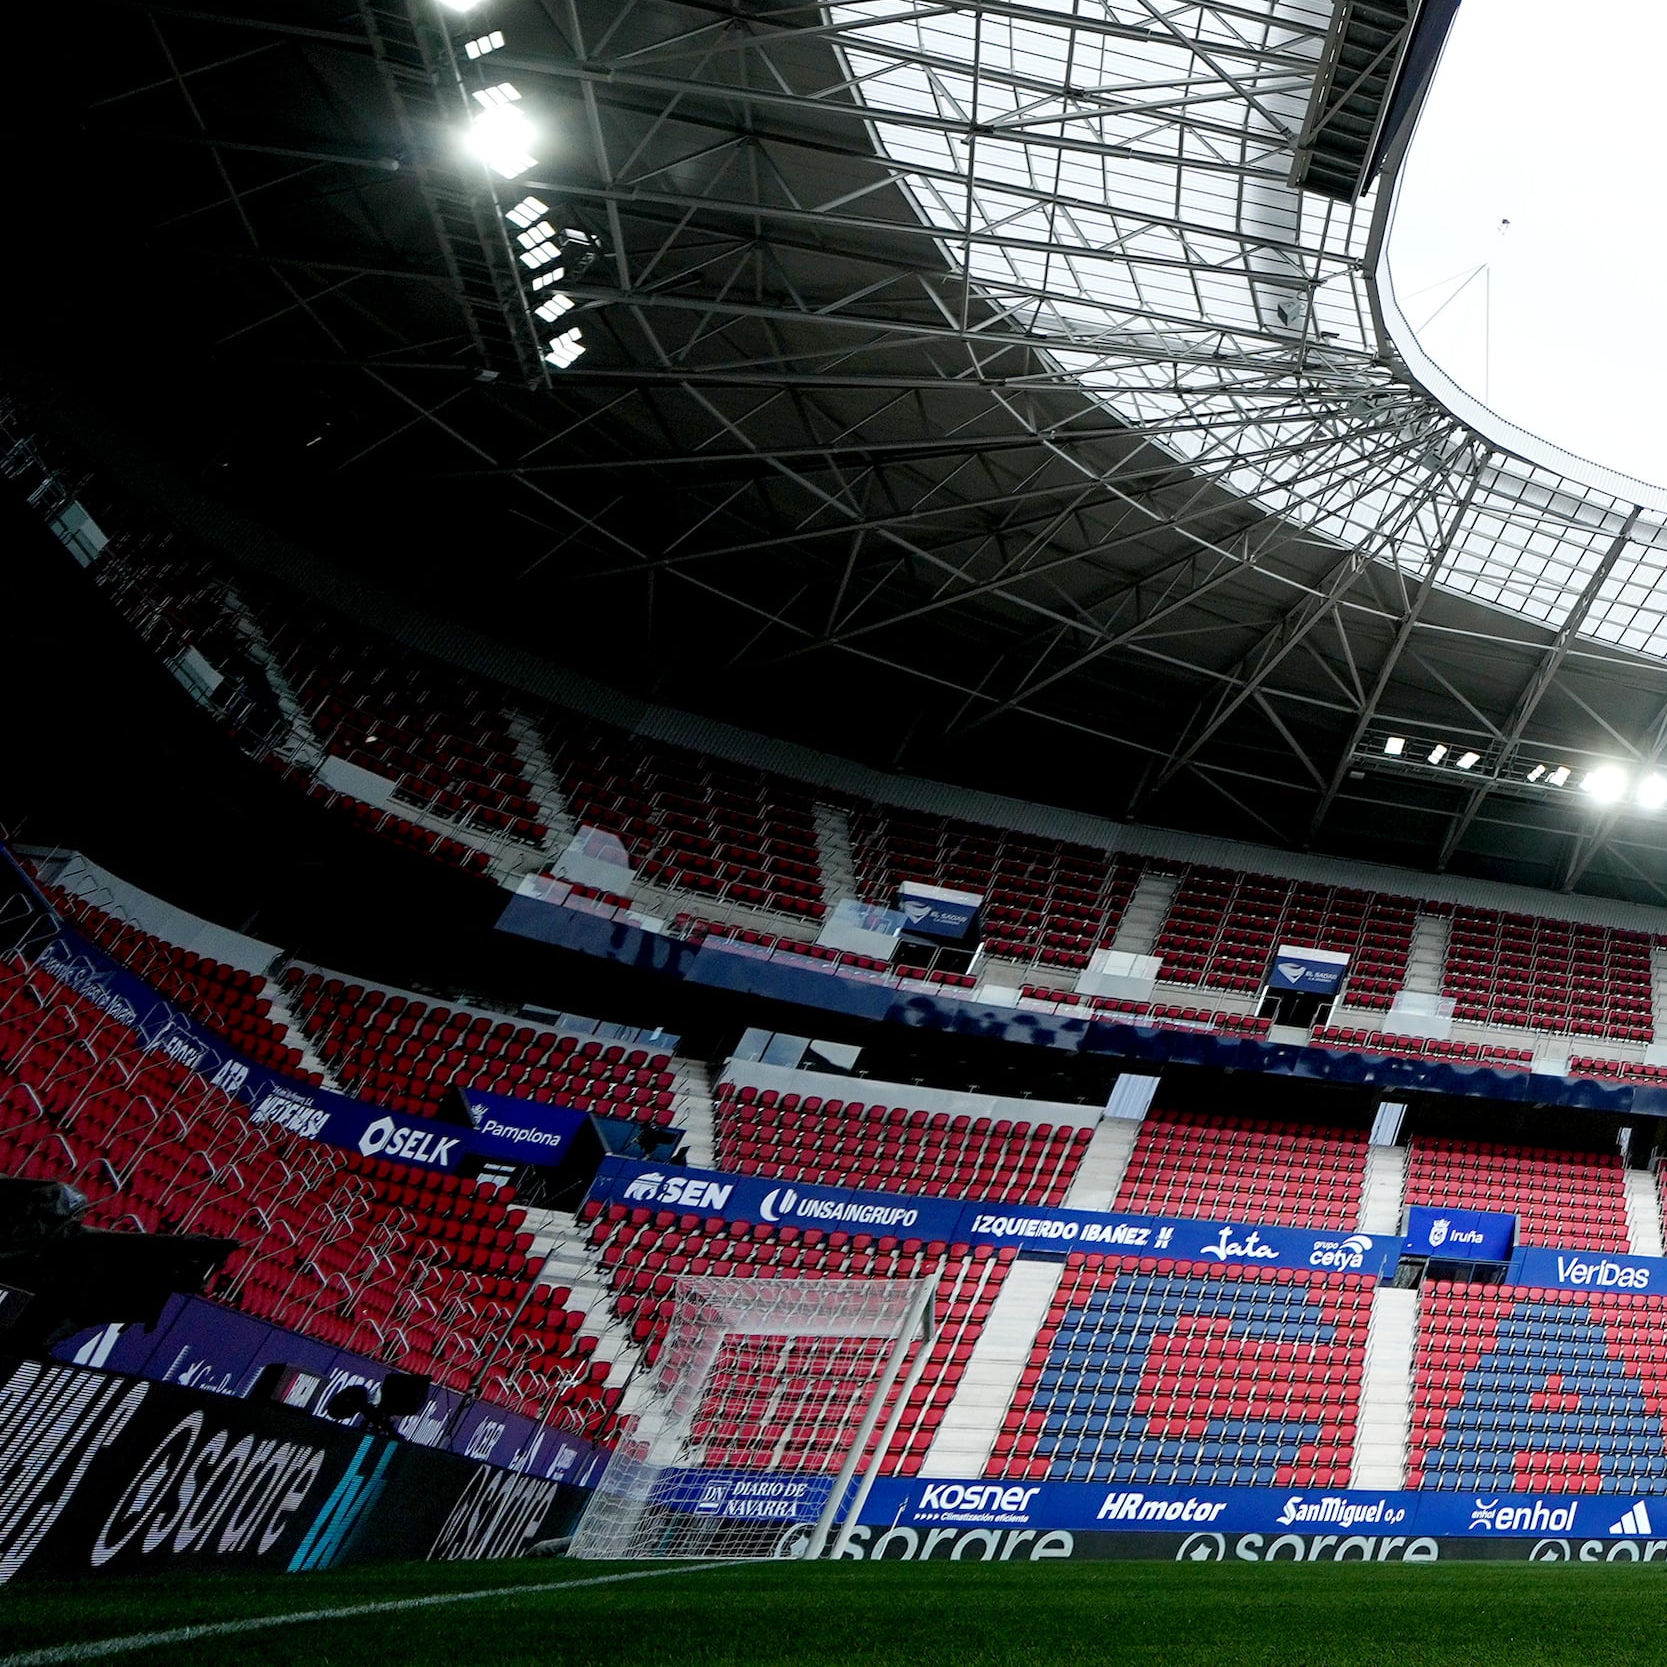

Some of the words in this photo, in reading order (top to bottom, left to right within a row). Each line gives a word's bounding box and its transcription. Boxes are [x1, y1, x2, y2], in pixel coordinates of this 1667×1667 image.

[386, 1127, 461, 1166] SELK
[481, 1120, 562, 1148] Pamplona
[1080, 1220, 1150, 1247] IBAÑEZ
[1312, 1240, 1340, 1251] grupo
[1449, 1228, 1484, 1245] Iruña
[1309, 1247, 1365, 1273] cetya
[733, 1480, 784, 1498] DIARIO
[785, 1482, 808, 1498] DE
[723, 1500, 799, 1518] NAVARRA
[1500, 1499, 1577, 1532] enhol
